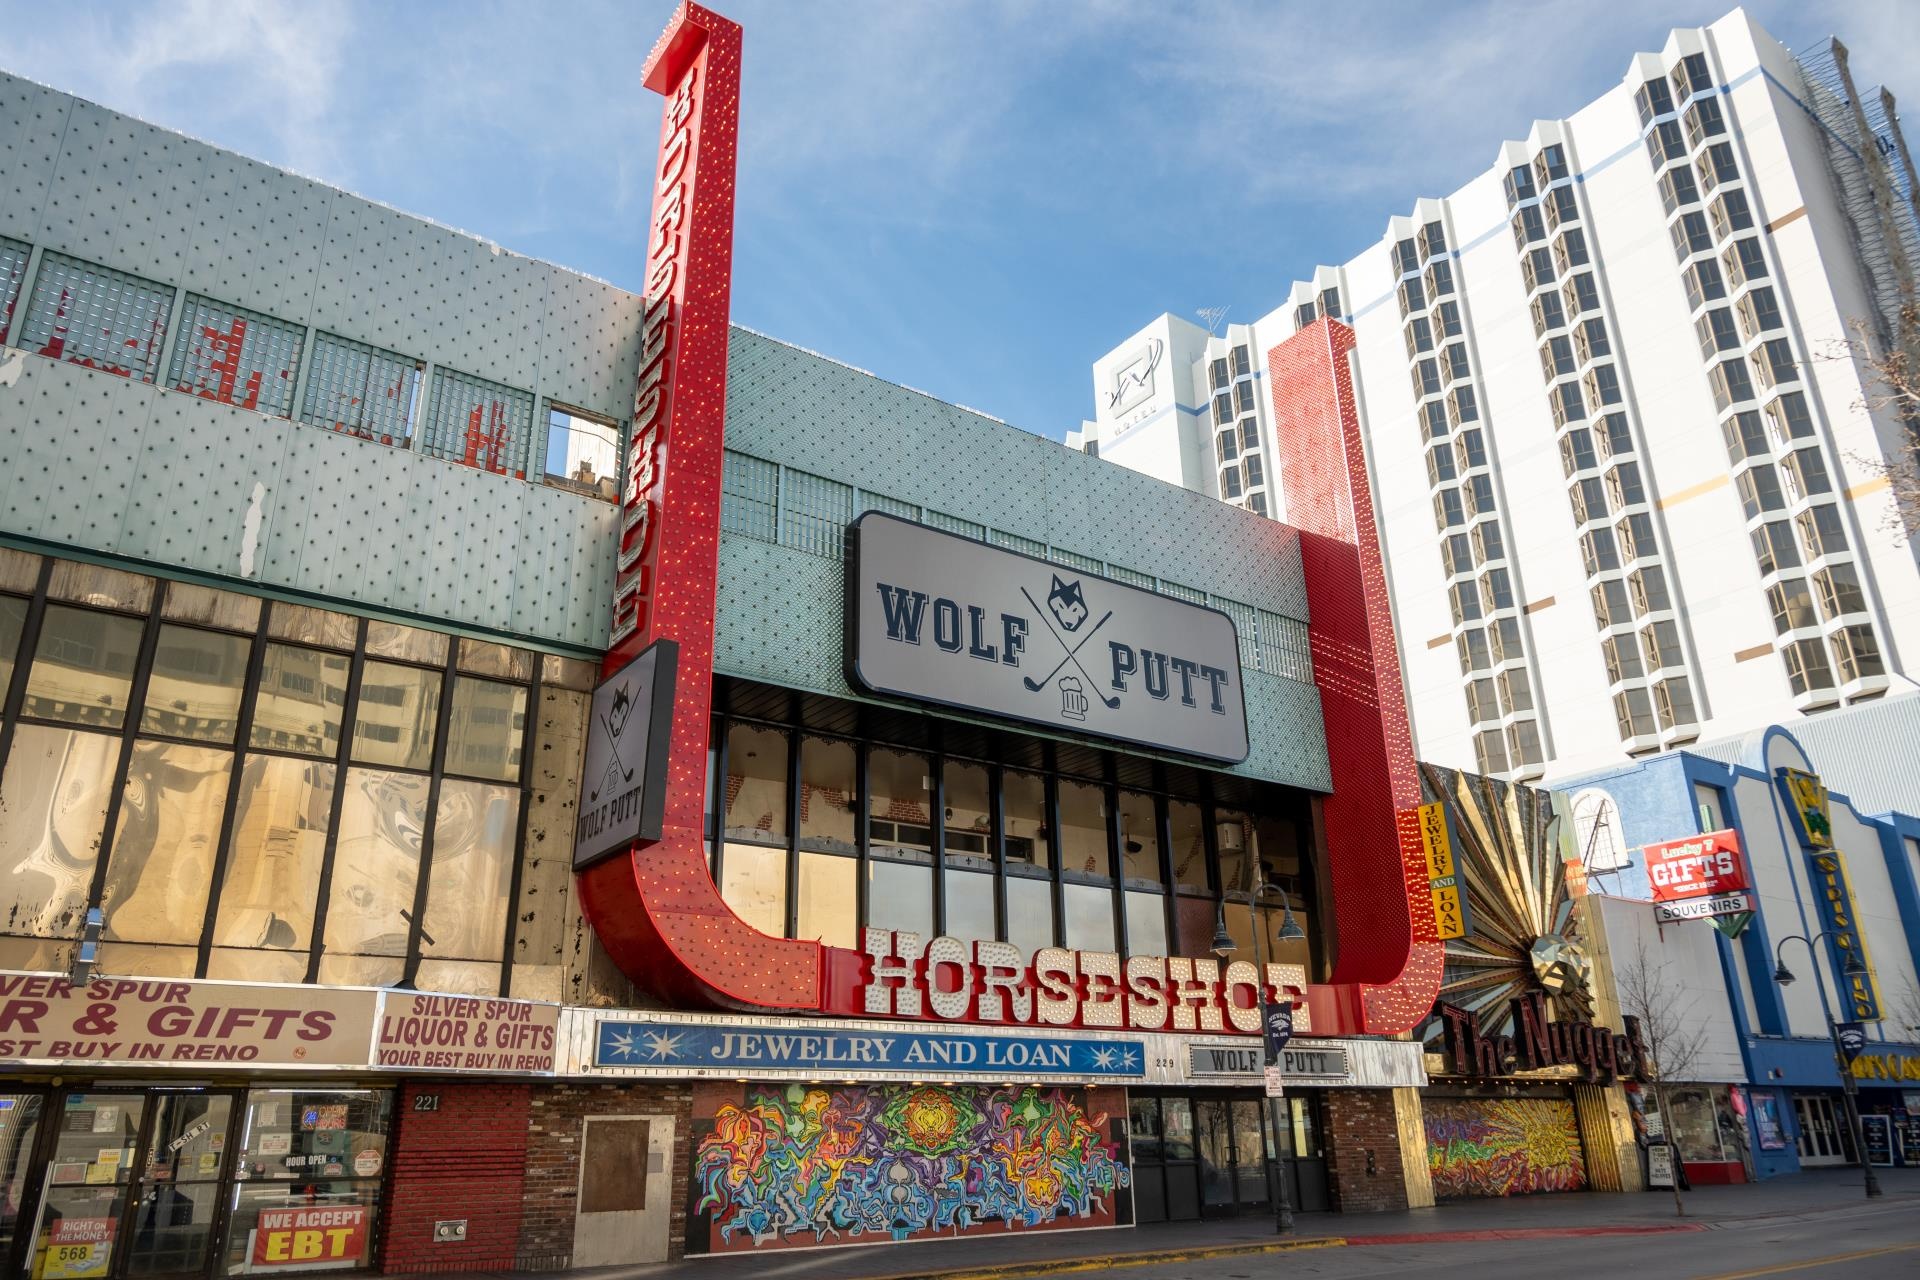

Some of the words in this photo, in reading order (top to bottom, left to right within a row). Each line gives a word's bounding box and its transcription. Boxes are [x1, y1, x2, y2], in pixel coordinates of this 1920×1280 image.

[877, 582, 1029, 668] WOLF
[1108, 640, 1228, 715] PUTT
[580, 804, 608, 844] WOLF
[608, 785, 641, 828] PUTT
[1425, 805, 1446, 876] JEWELRY
[1661, 843, 1703, 860] Lucky
[1651, 851, 1735, 887] GIFTS
[1433, 877, 1455, 889] AND
[1439, 890, 1457, 936] LOAN
[1662, 898, 1742, 919] SOUVENIRS
[86, 980, 192, 1003] SPUR
[864, 927, 1312, 1033] HORSESHOE
[412, 994, 481, 1019] SILVER
[484, 999, 533, 1022] SPUR
[1268, 1012, 1291, 1023] NEVADA
[72, 1002, 119, 1036] &
[147, 1005, 337, 1042] GIFTS
[380, 1015, 469, 1049] LIQUOR
[473, 1021, 488, 1048] &
[495, 1022, 555, 1051] GIFTS
[1439, 1001, 1518, 1077] The
[1511, 988, 1652, 1088] Nugget
[46, 1041, 122, 1058] BUY
[127, 1043, 165, 1059] IN
[171, 1043, 259, 1061] RENO
[378, 1049, 421, 1066] YOUR
[423, 1051, 463, 1068] BEST
[464, 1053, 496, 1069] BUY
[497, 1054, 513, 1070] IN
[515, 1055, 553, 1071] RENO
[711, 1033, 896, 1063] JEWELRY
[903, 1039, 977, 1064] AND
[985, 1041, 1073, 1068] LOAN
[1211, 1050, 1258, 1071] WOLF
[1285, 1052, 1328, 1073] PUTT
[1156, 1058, 1175, 1068] 229
[414, 1095, 440, 1111] 221
[285, 1155, 306, 1167] HOUR
[308, 1154, 327, 1166] OPEN
[62, 1221, 92, 1232] RIGHT
[94, 1221, 107, 1230] ON
[263, 1213, 293, 1229] WE
[295, 1210, 363, 1228] ACCEPT
[55, 1233, 73, 1241] THE
[74, 1230, 111, 1241] MONEY
[265, 1228, 355, 1262] EBT
[59, 1246, 88, 1261] 568
